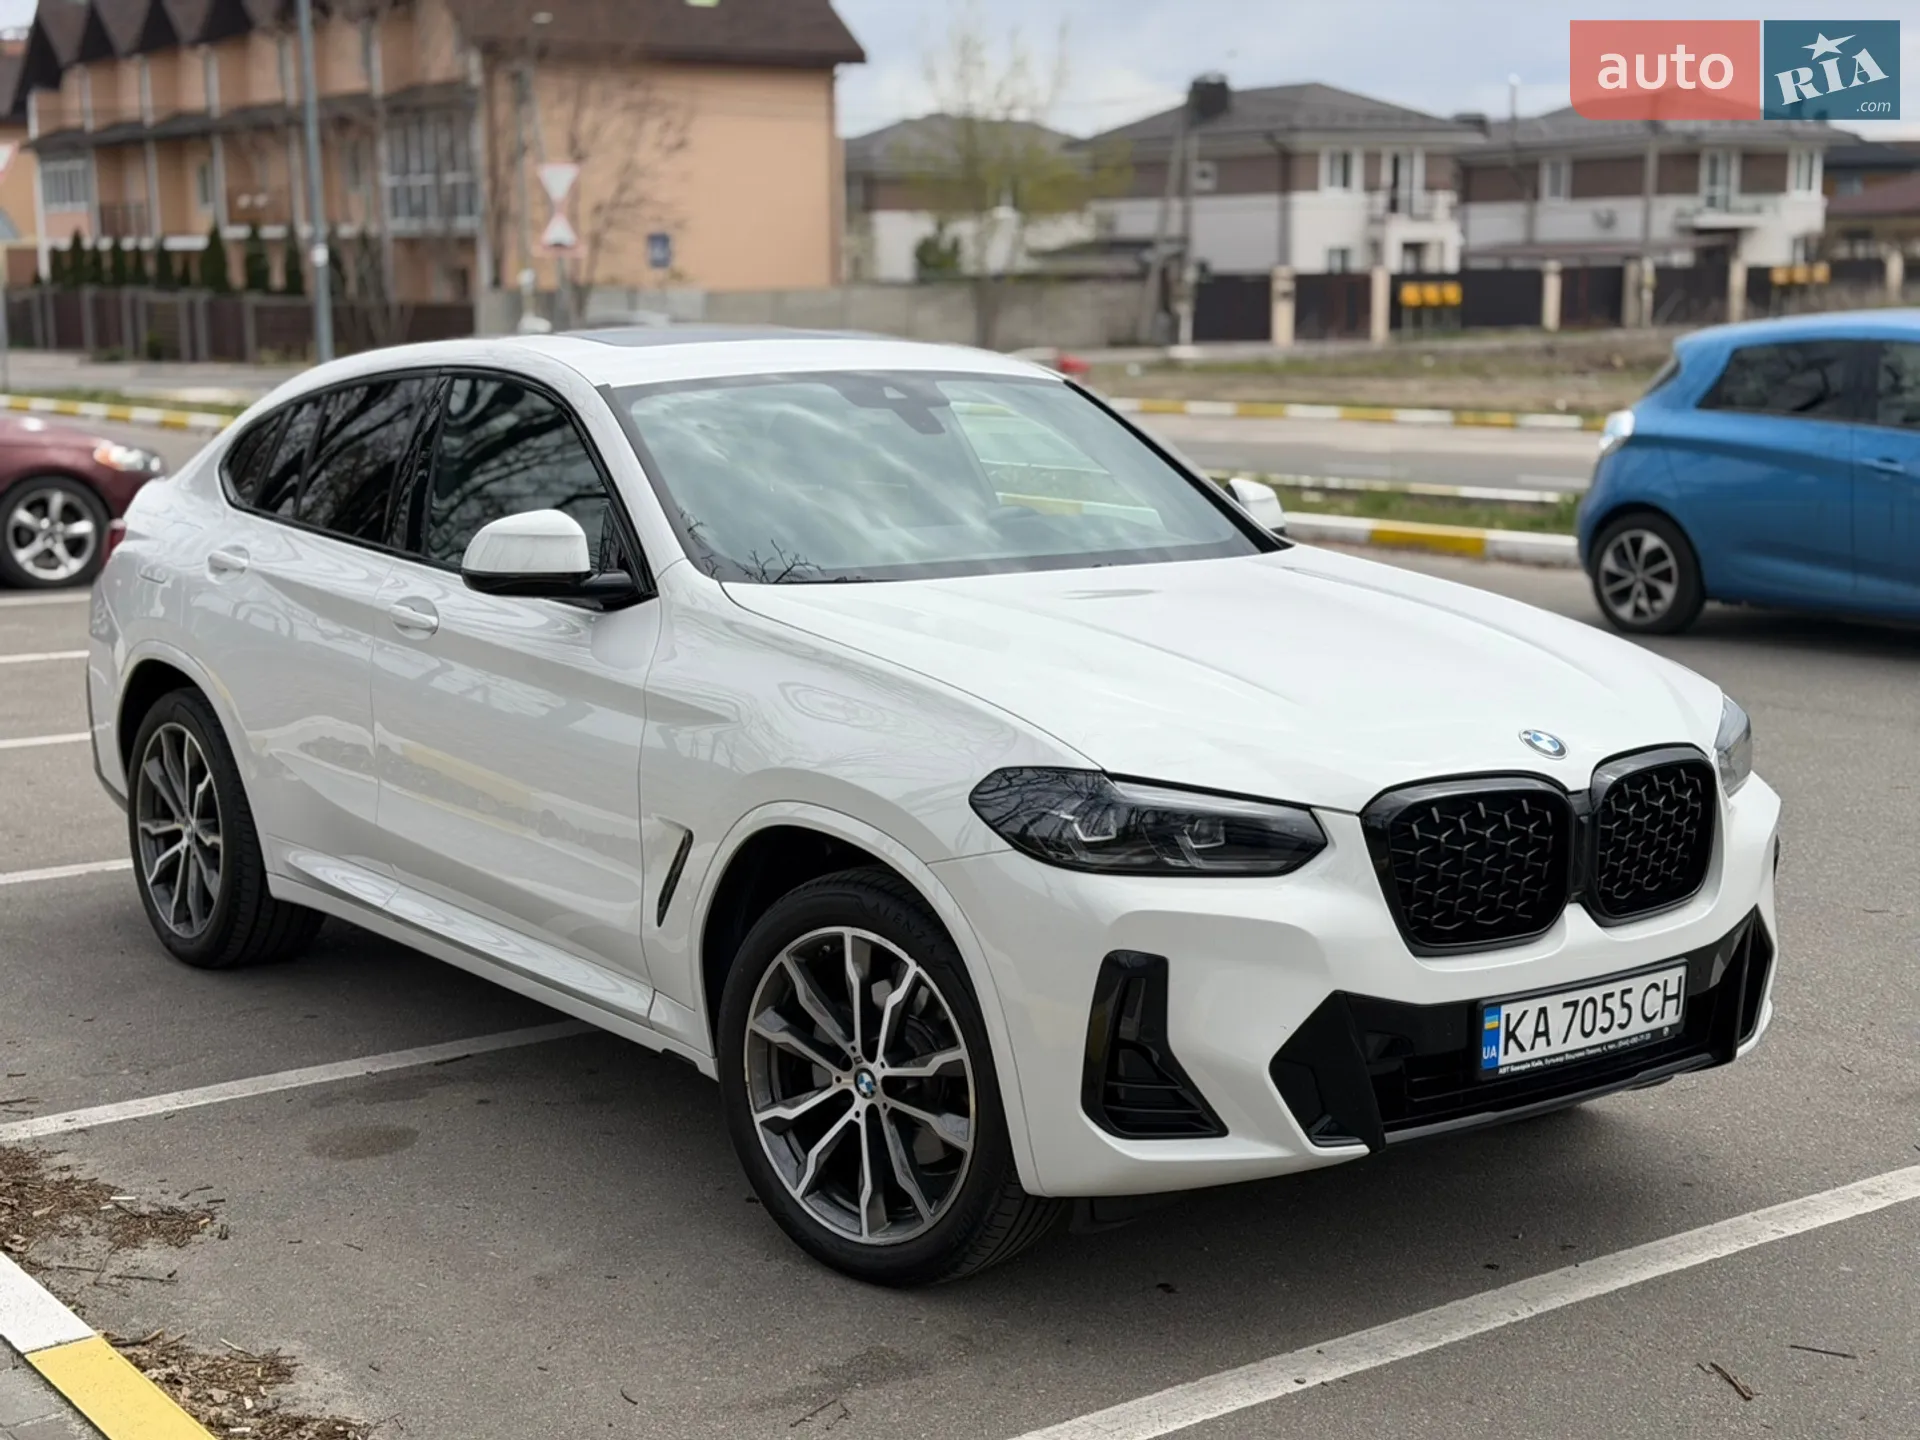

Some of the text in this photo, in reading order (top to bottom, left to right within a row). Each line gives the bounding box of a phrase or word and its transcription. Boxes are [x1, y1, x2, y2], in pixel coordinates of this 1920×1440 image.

[1503, 1006, 1551, 1056] KA
[1561, 987, 1633, 1045] 7055
[1641, 975, 1683, 1023] CH
[1482, 1045, 1497, 1060] UA
